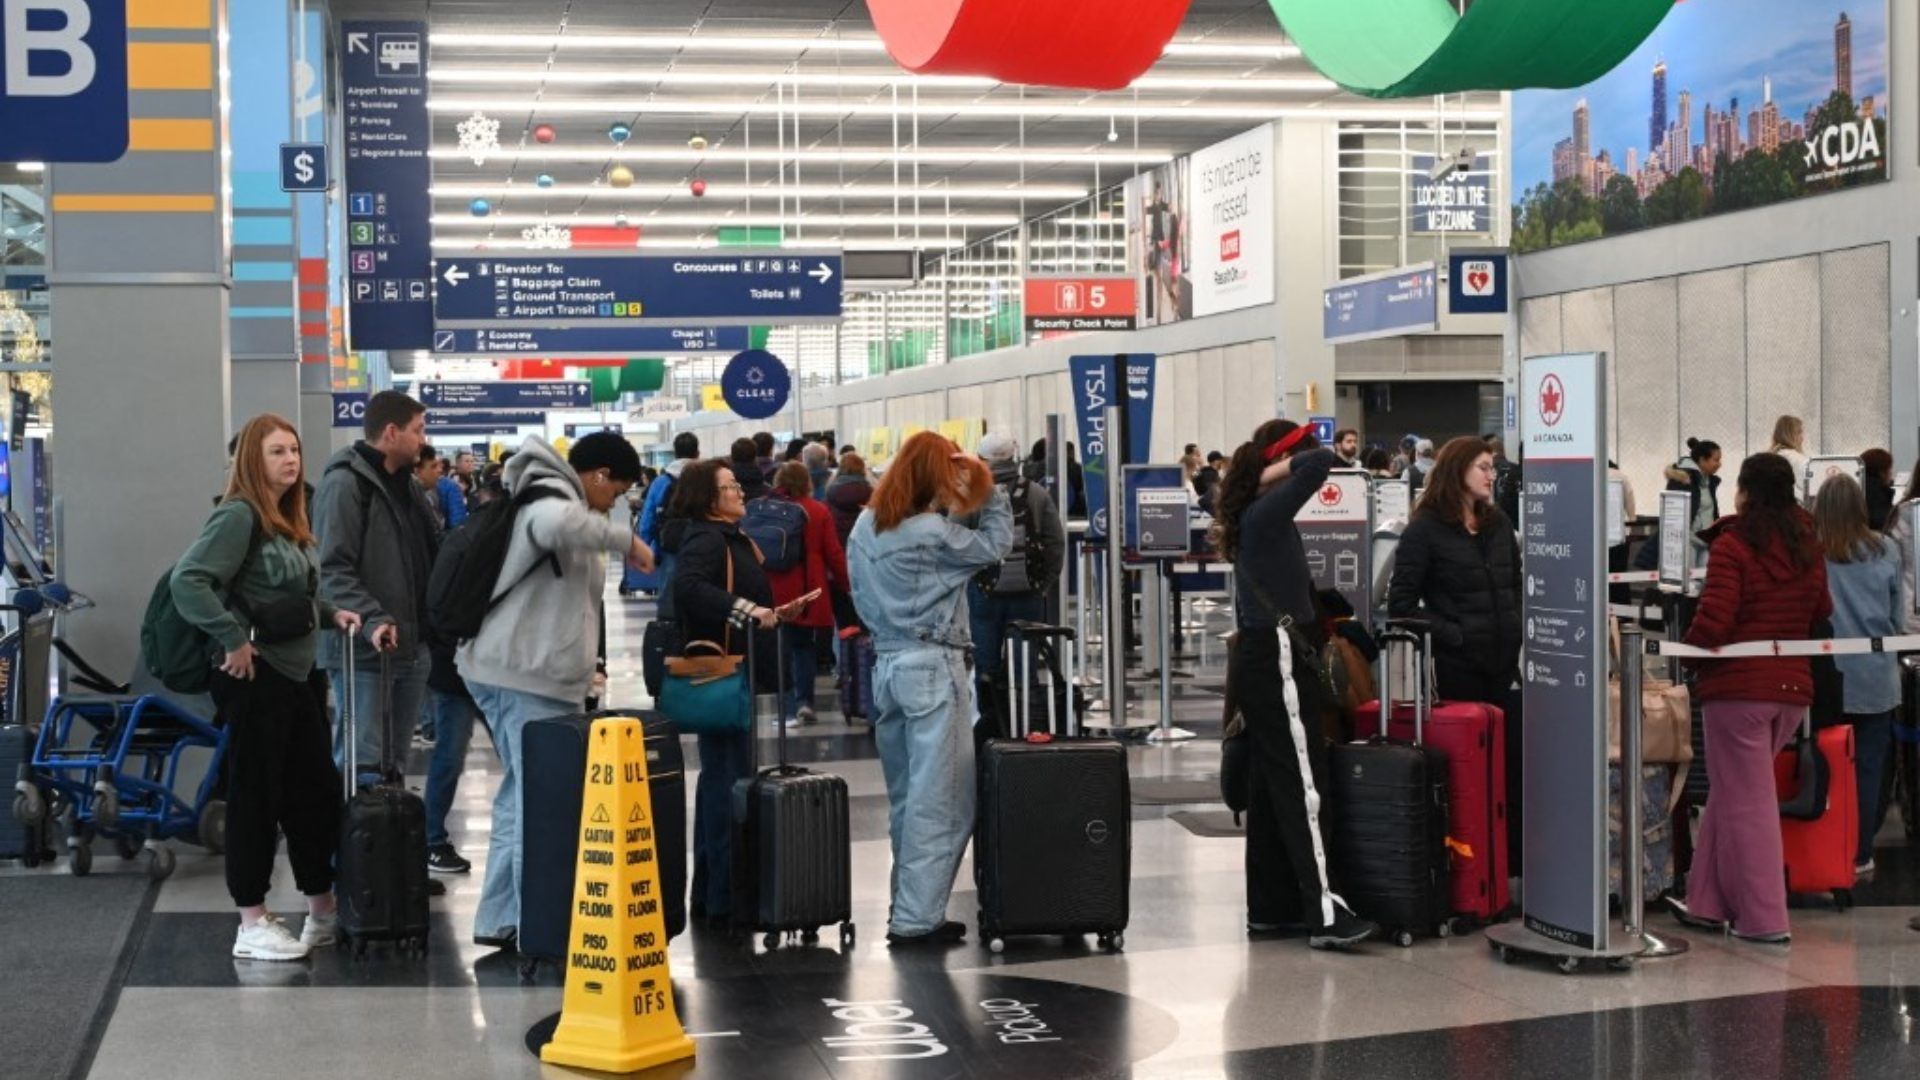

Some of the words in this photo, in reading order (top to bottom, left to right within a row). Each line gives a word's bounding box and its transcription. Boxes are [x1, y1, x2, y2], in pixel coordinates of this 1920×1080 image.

[3, 0, 97, 97] B
[348, 86, 378, 97] Airport
[380, 86, 409, 96] Transit
[1821, 117, 1880, 168] CDA
[292, 150, 314, 184] $
[1468, 185, 1486, 206] THE
[355, 196, 365, 213] 1
[356, 225, 369, 242] 3
[357, 254, 369, 270] 5
[494, 263, 542, 274] Elevator
[546, 263, 564, 274] To:
[673, 261, 738, 273] Concourses
[1468, 263, 1488, 271] AED
[511, 277, 564, 289] Baggage
[566, 277, 601, 288] Claim
[513, 291, 556, 302] Ground
[558, 291, 616, 303] Transport
[750, 288, 785, 300] Toilets
[1089, 285, 1106, 310] 5
[513, 304, 554, 316] Airport
[556, 304, 596, 315] Transit
[1033, 318, 1071, 330] Security
[1073, 318, 1102, 329] Check
[1104, 318, 1128, 328] Point
[490, 330, 532, 342] Economy
[671, 328, 704, 341] Chapel
[490, 341, 516, 351] Rental
[736, 388, 776, 398] CLEAR
[1085, 364, 1106, 411] TSA
[338, 401, 366, 419] 2C
[1544, 432, 1574, 443] CANADA
[624, 761, 645, 783] UL
[586, 881, 609, 898] WET
[630, 879, 652, 897] WET
[578, 901, 614, 919] FLOOR
[627, 898, 657, 918] FLOOR
[582, 932, 608, 951] PISO
[633, 931, 655, 950] PISO
[571, 952, 617, 973] MOJADO
[627, 950, 665, 972] MOJADO
[820, 997, 950, 1062] Uber
[979, 998, 1063, 1044] Pickup
